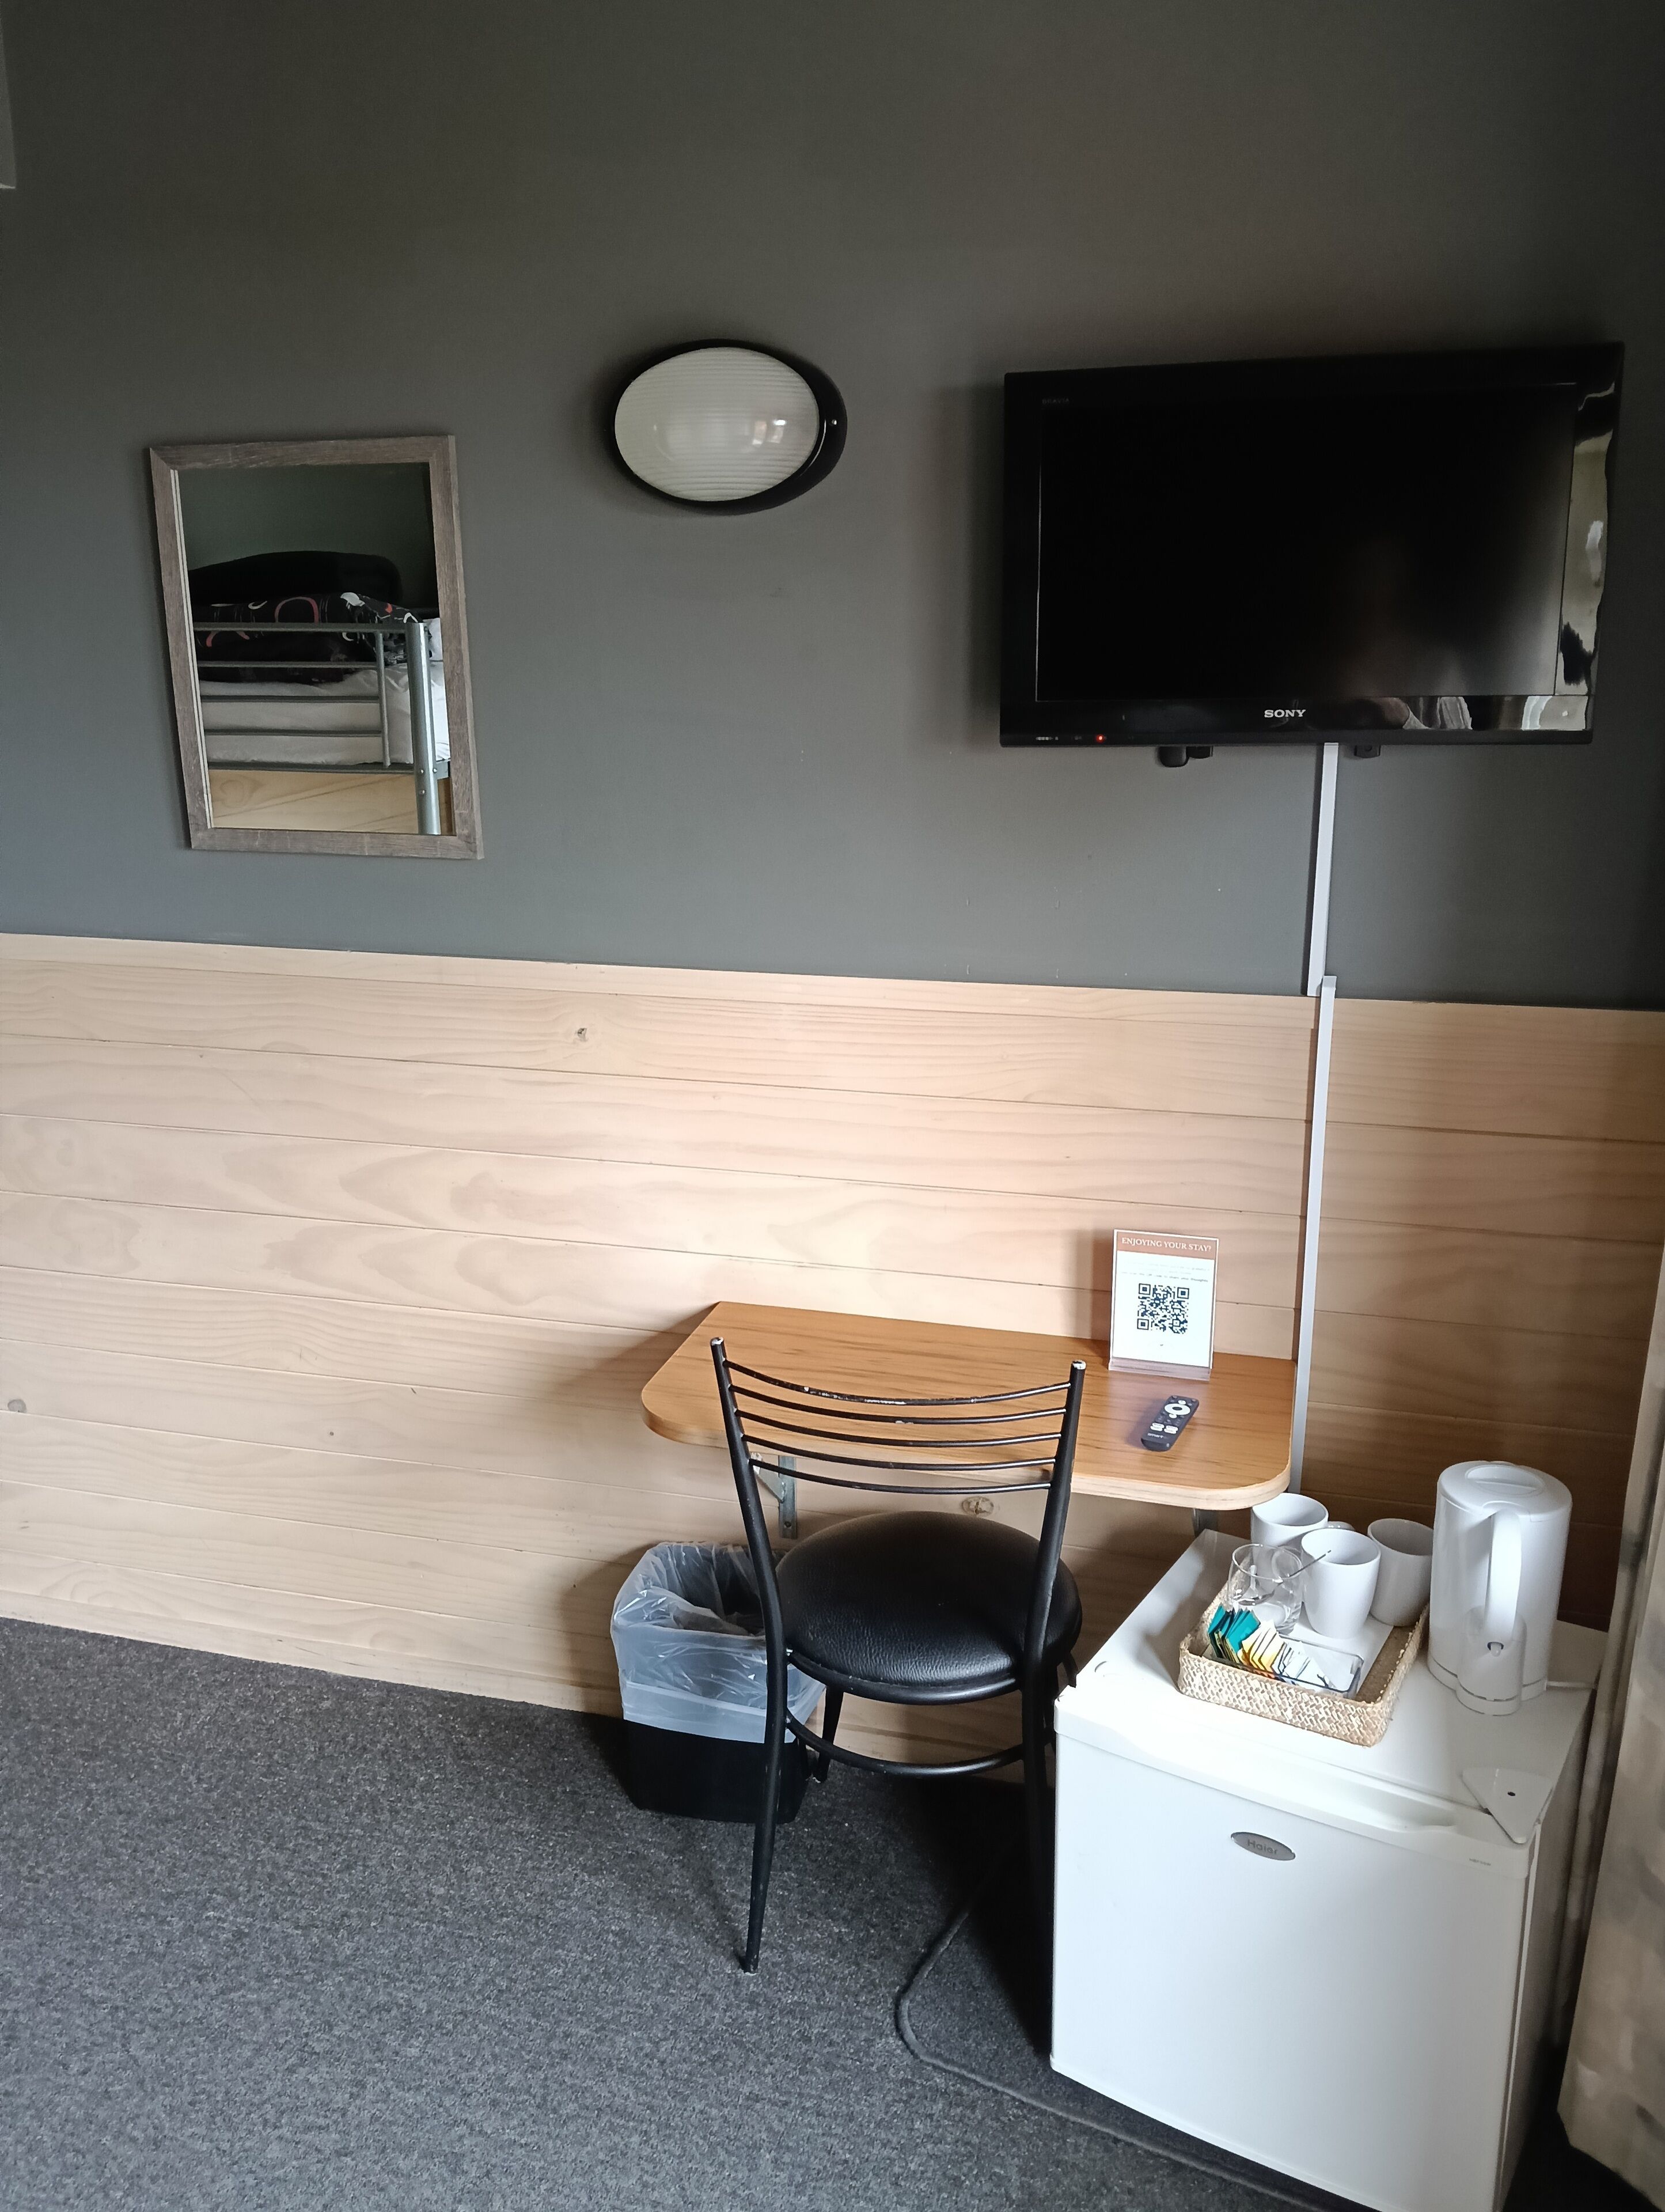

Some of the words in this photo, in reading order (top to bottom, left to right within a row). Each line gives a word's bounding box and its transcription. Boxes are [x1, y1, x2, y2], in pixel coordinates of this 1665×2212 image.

[1264, 709, 1306, 718] SONY
[1121, 1237, 1162, 1248] ENJOYING
[1164, 1241, 1187, 1250] YOUR
[1188, 1243, 1212, 1252] STAY?
[1247, 1839, 1278, 1855] Haier
